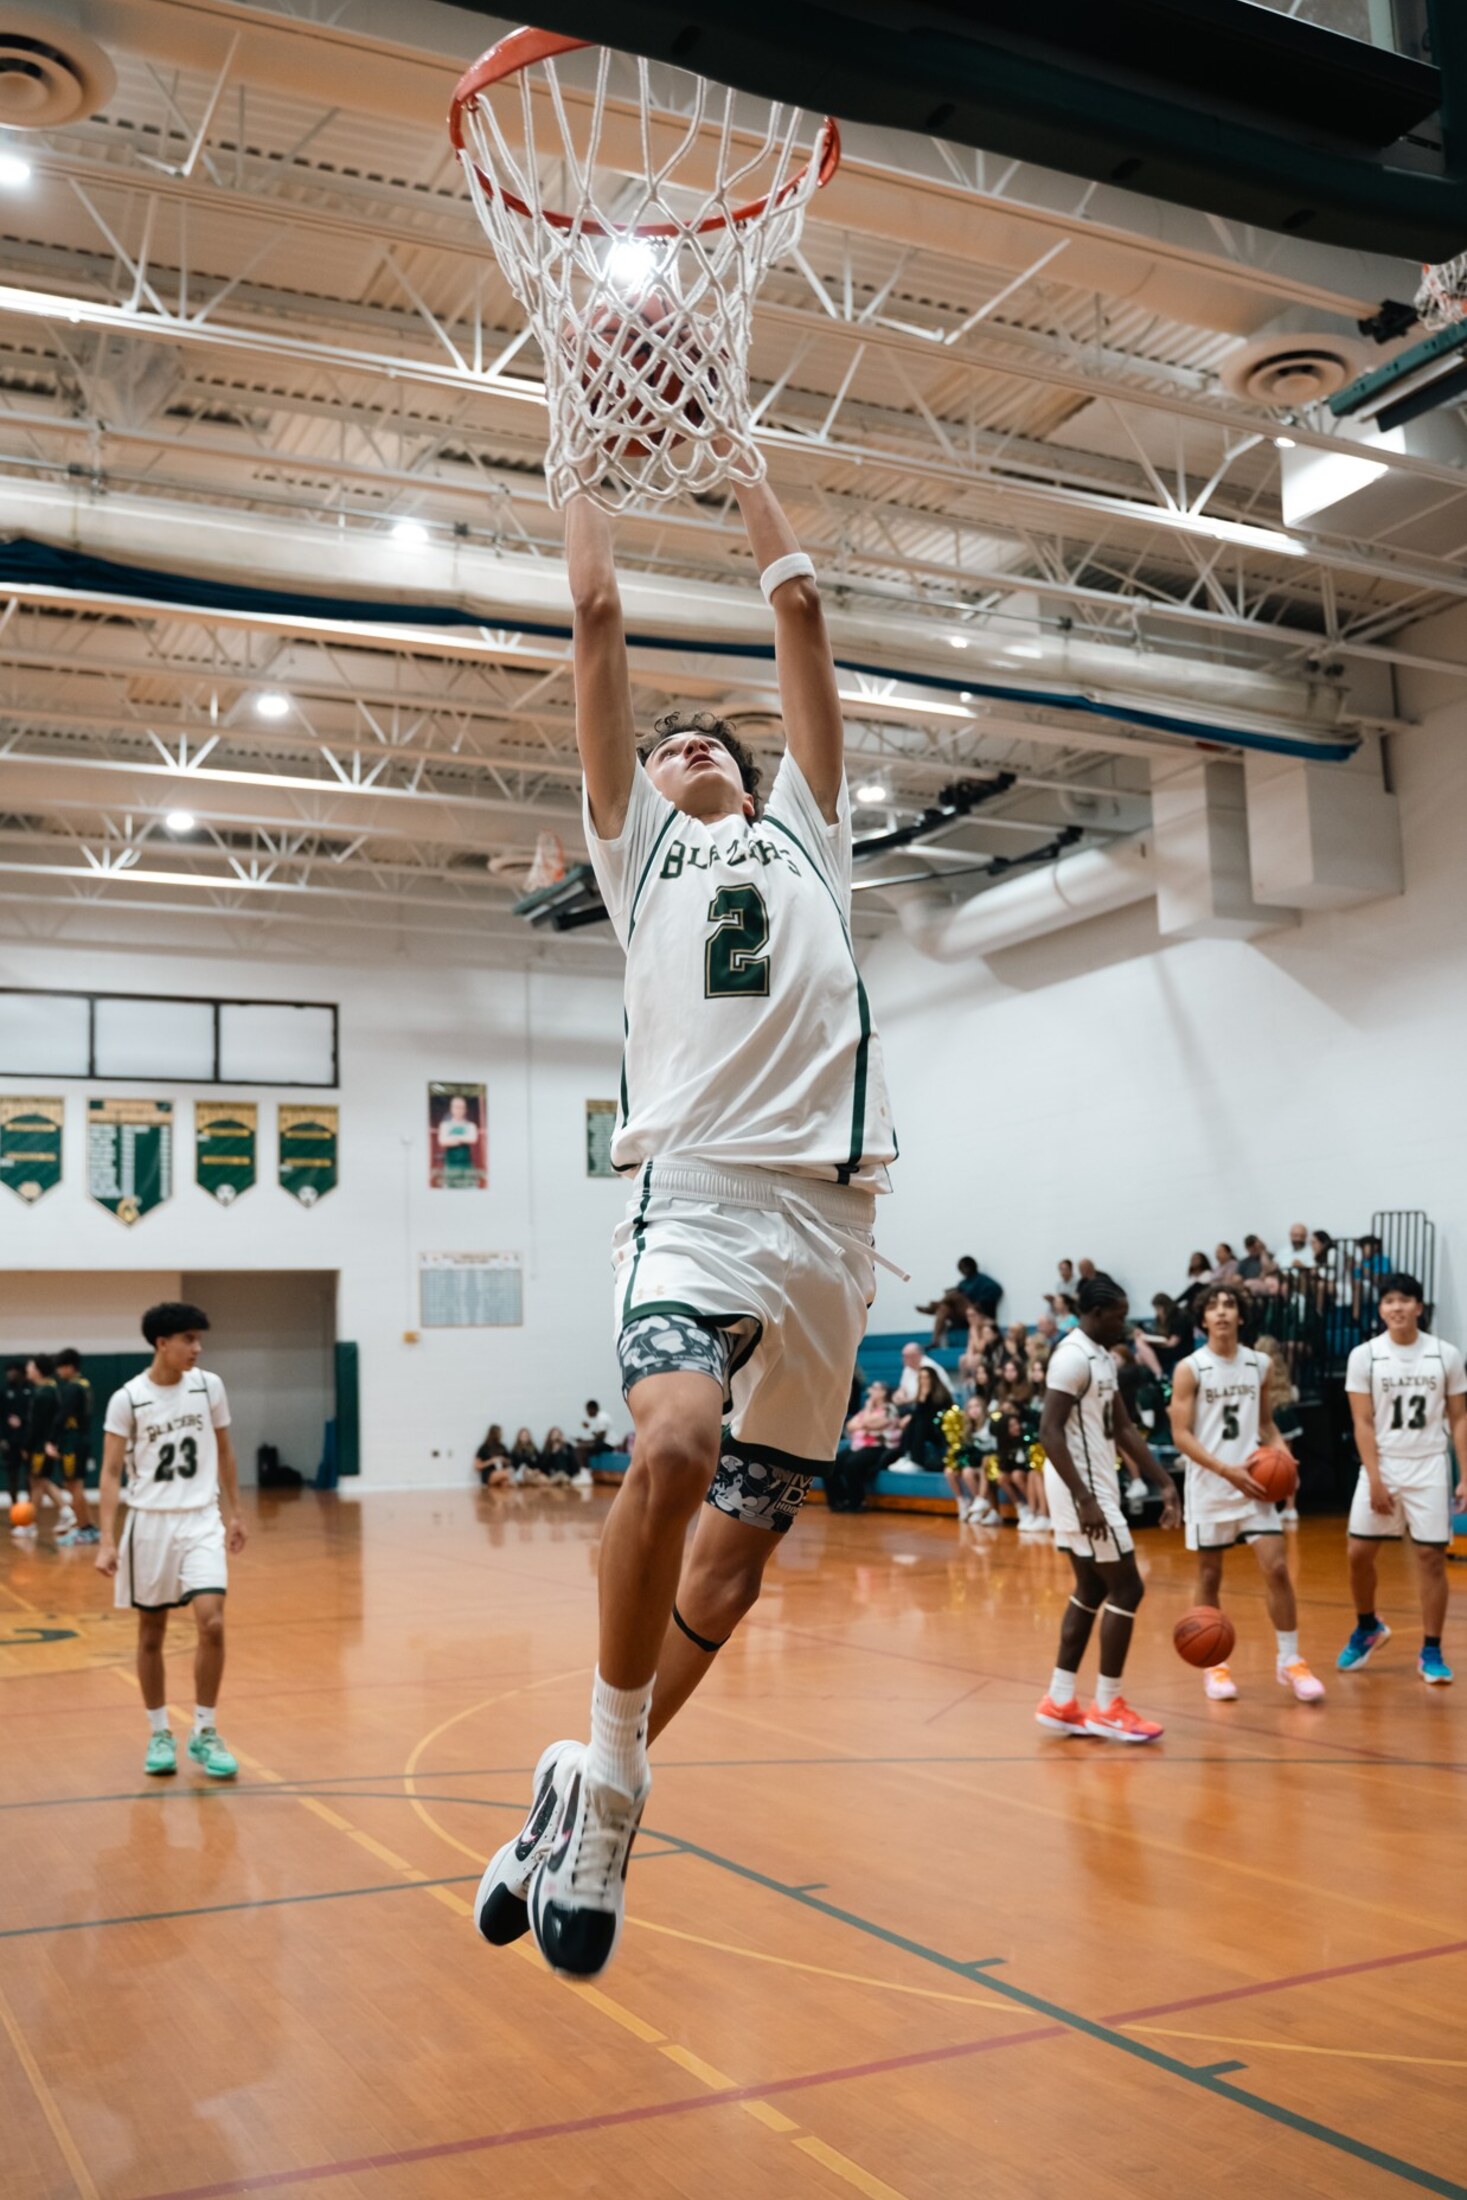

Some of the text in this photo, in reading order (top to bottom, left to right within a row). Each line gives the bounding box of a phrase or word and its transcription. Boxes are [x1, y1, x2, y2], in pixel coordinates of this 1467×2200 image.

[704, 882, 770, 999] 2
[1222, 1404, 1239, 1440] 5
[1391, 1395, 1426, 1430] 13
[154, 1436, 197, 1482] 23
